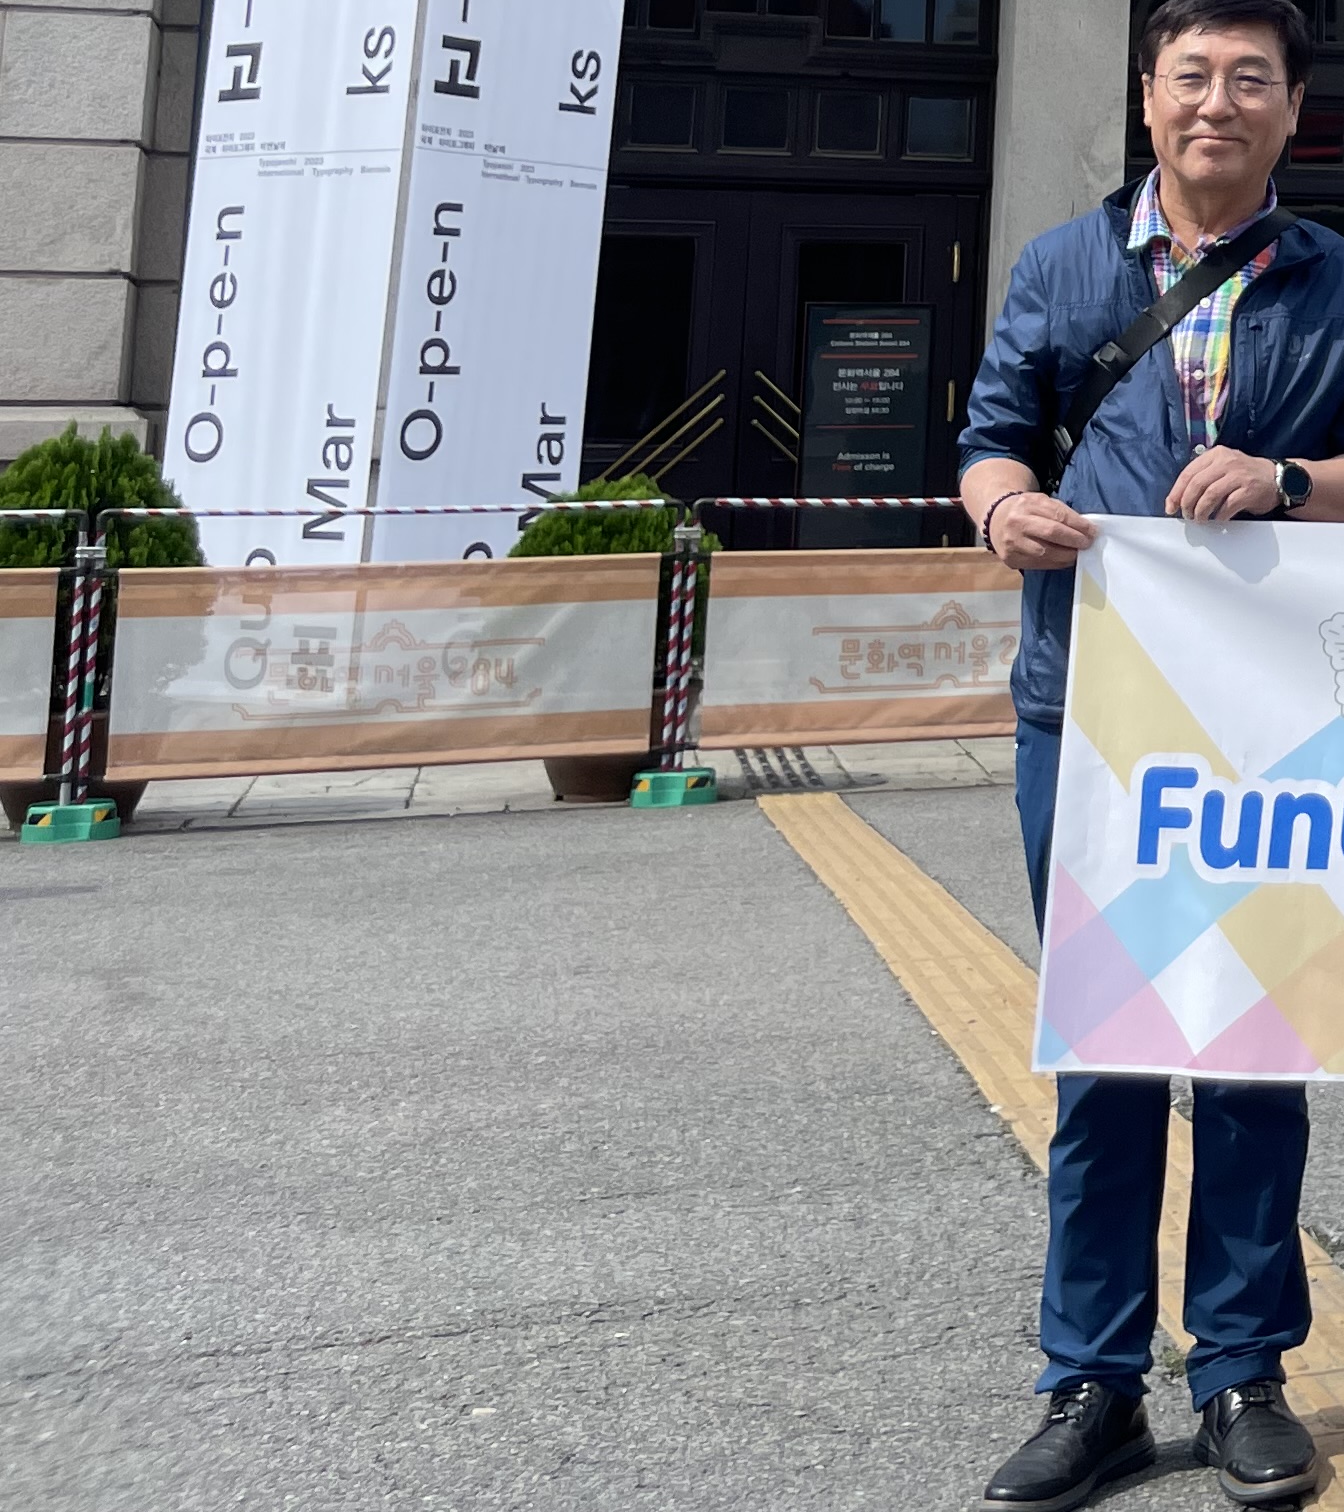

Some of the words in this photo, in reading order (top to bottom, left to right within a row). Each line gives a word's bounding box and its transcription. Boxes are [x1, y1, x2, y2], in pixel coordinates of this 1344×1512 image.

[345, 25, 396, 96] ks
[558, 48, 602, 115] ks
[184, 205, 245, 464] O-p-e-n
[400, 201, 464, 461] O-p-e-n
[302, 403, 356, 541] Mar
